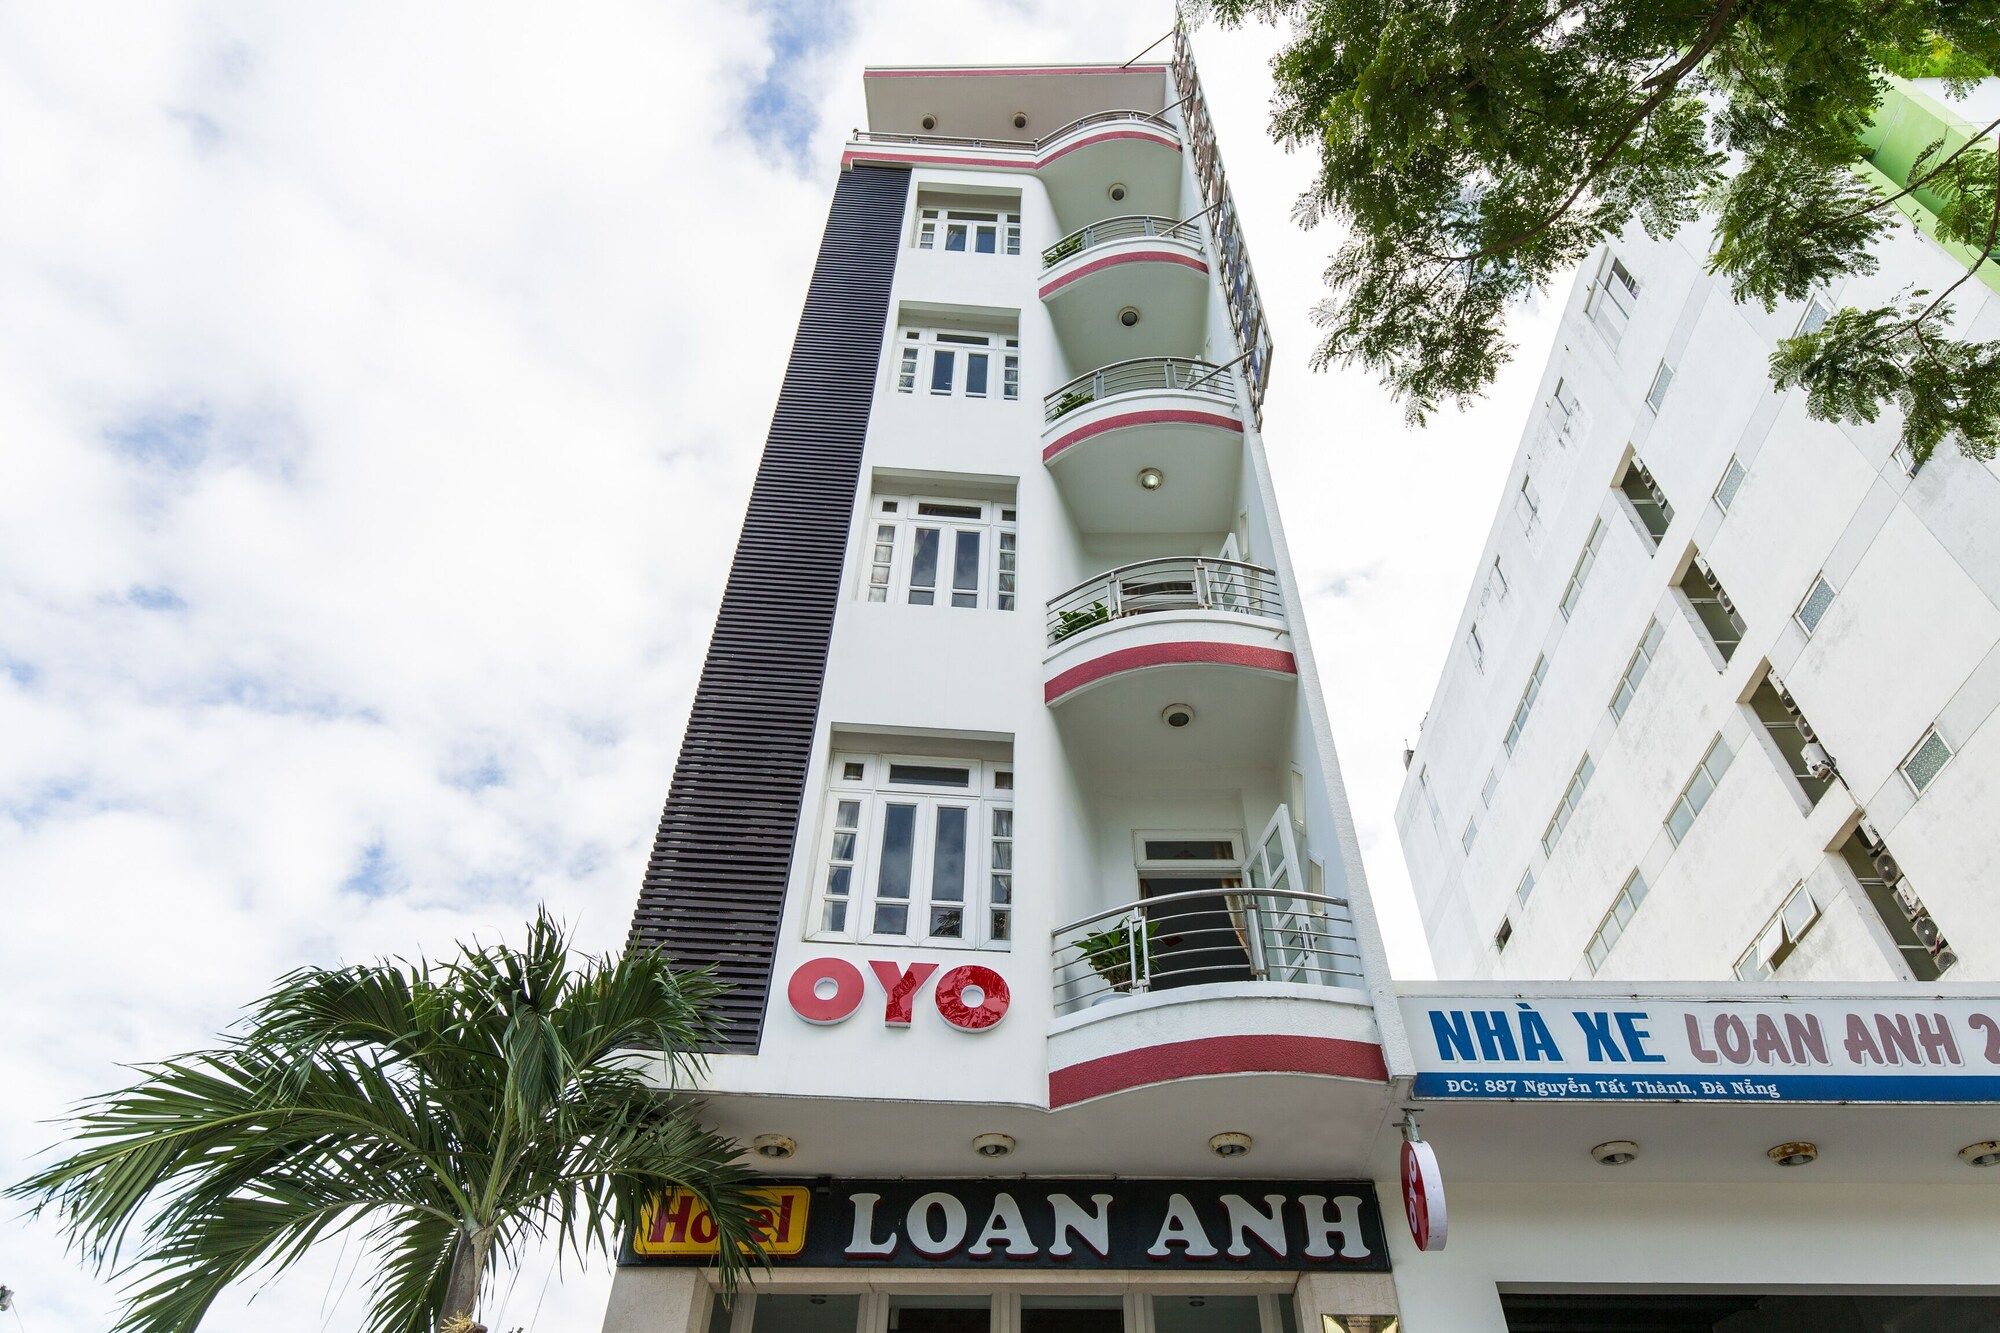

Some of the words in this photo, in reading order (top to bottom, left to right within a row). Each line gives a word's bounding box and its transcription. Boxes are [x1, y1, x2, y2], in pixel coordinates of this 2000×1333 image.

[787, 957, 1011, 1032] OYO
[1428, 1003, 1564, 1062] NHÀ
[1572, 1011, 1667, 1063] XE
[1684, 1013, 1830, 1065] LOAN
[1843, 1013, 1962, 1065] ANH
[1446, 1080, 1479, 1093] ĐC:
[1484, 1080, 1517, 1093] 887
[1523, 1077, 1592, 1097] Nguyễn
[1595, 1078, 1628, 1094] Tất
[1632, 1081, 1697, 1096] Thành,
[1700, 1081, 1728, 1095] Đà
[1730, 1078, 1781, 1099] Nẵng
[649, 1194, 795, 1244] Hoel
[844, 1191, 1114, 1258] LOAN
[1147, 1193, 1371, 1259] ANH
